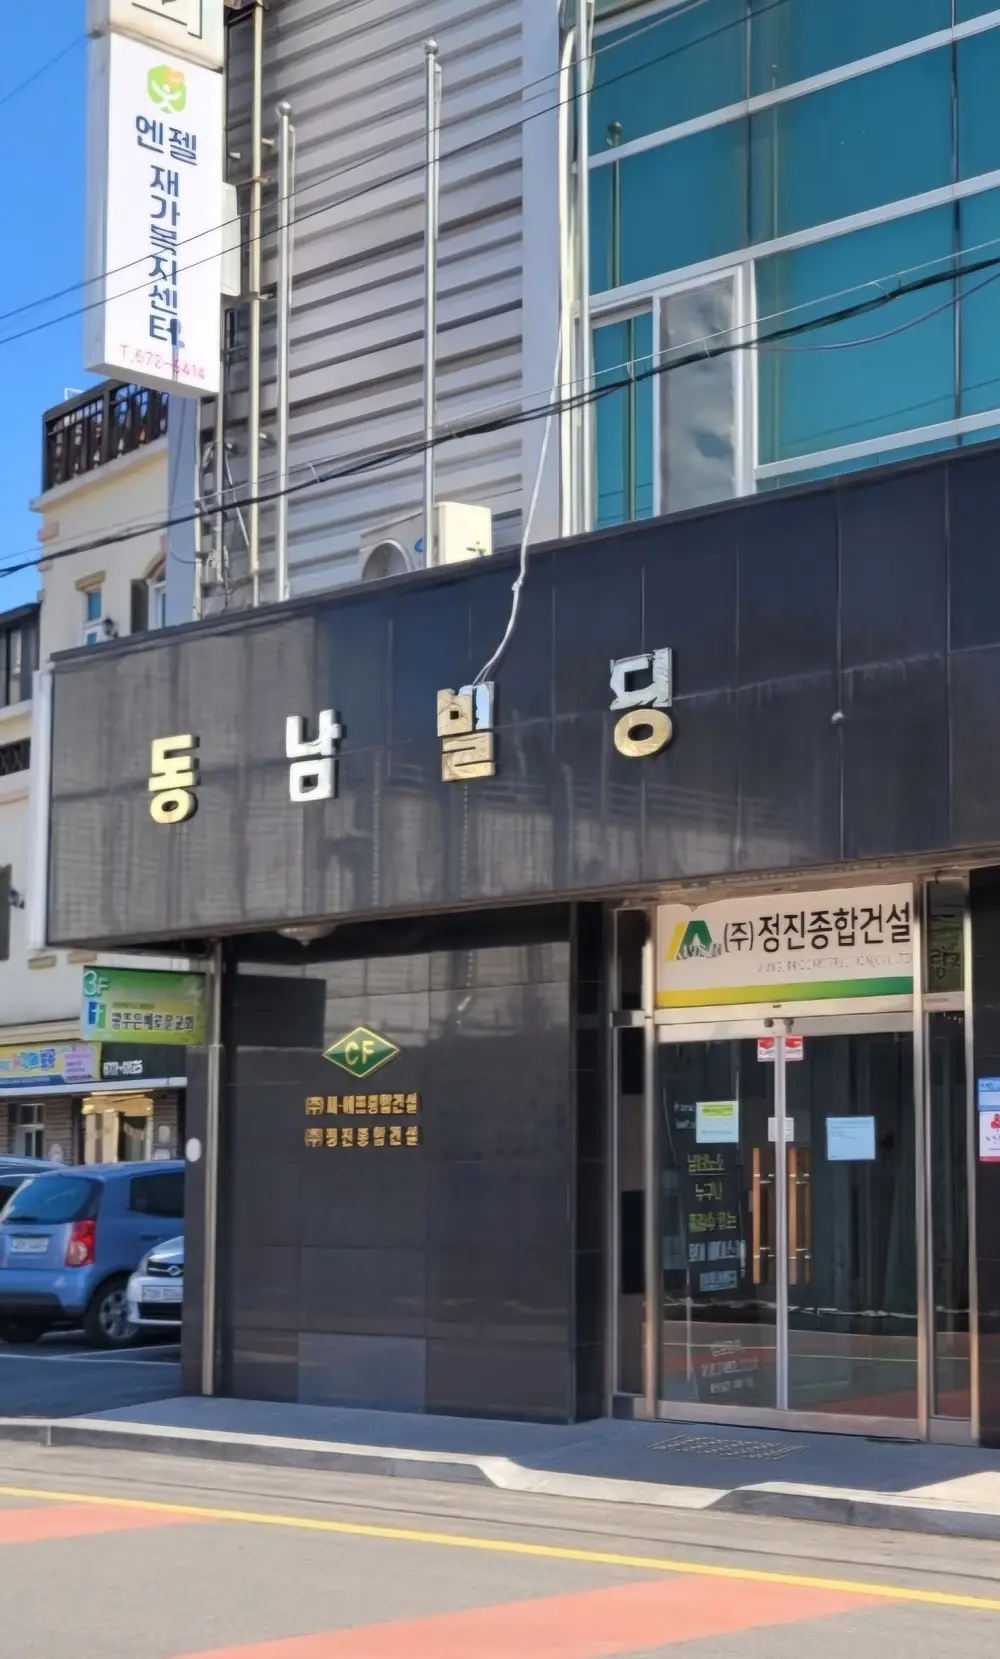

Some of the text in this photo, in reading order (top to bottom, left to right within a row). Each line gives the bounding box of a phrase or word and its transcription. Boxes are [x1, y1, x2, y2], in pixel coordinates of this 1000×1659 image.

[135, 114, 198, 166] 엔젤
[723, 901, 911, 953] (주)정진종합건설
[345, 1040, 375, 1066] CF
